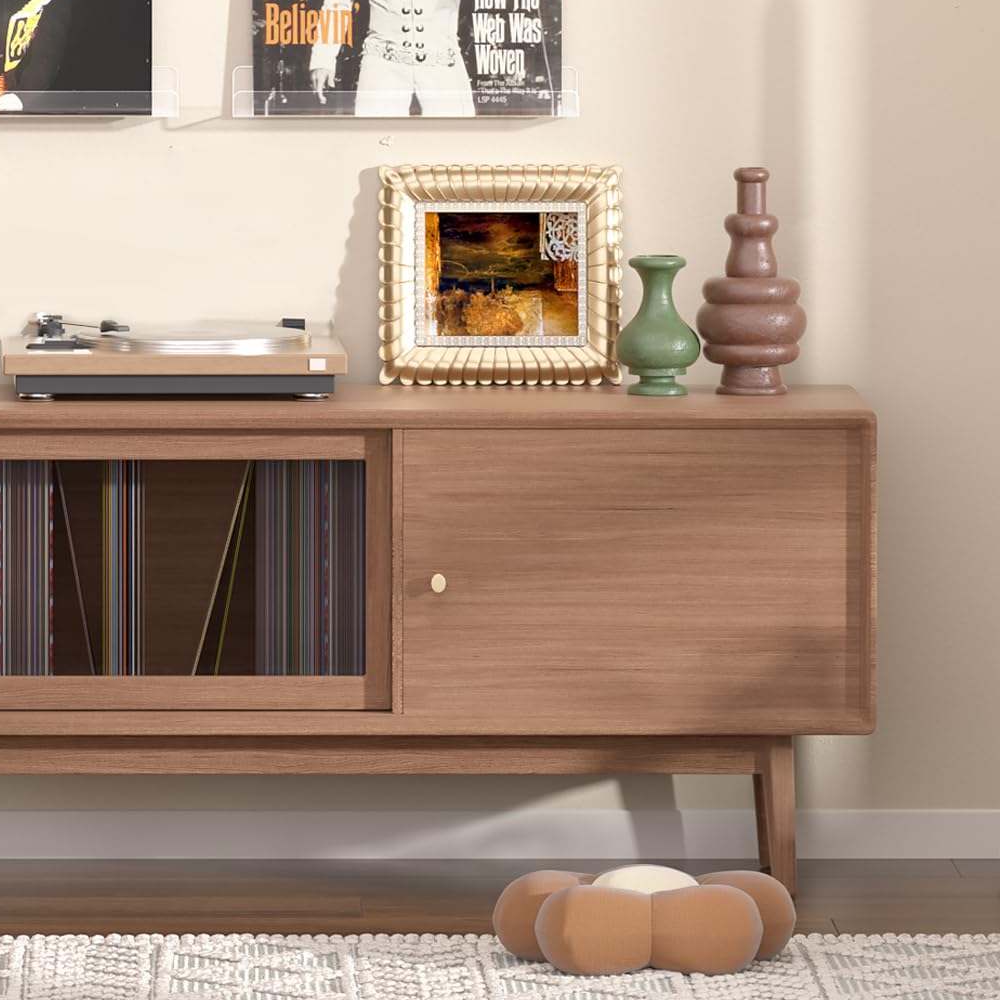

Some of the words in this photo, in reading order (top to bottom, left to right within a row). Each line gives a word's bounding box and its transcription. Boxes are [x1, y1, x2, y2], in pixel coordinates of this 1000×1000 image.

[265, 1, 361, 48] Believin'
[473, 12, 506, 44] Web
[509, 12, 542, 44] Was
[475, 45, 526, 77] Woven
